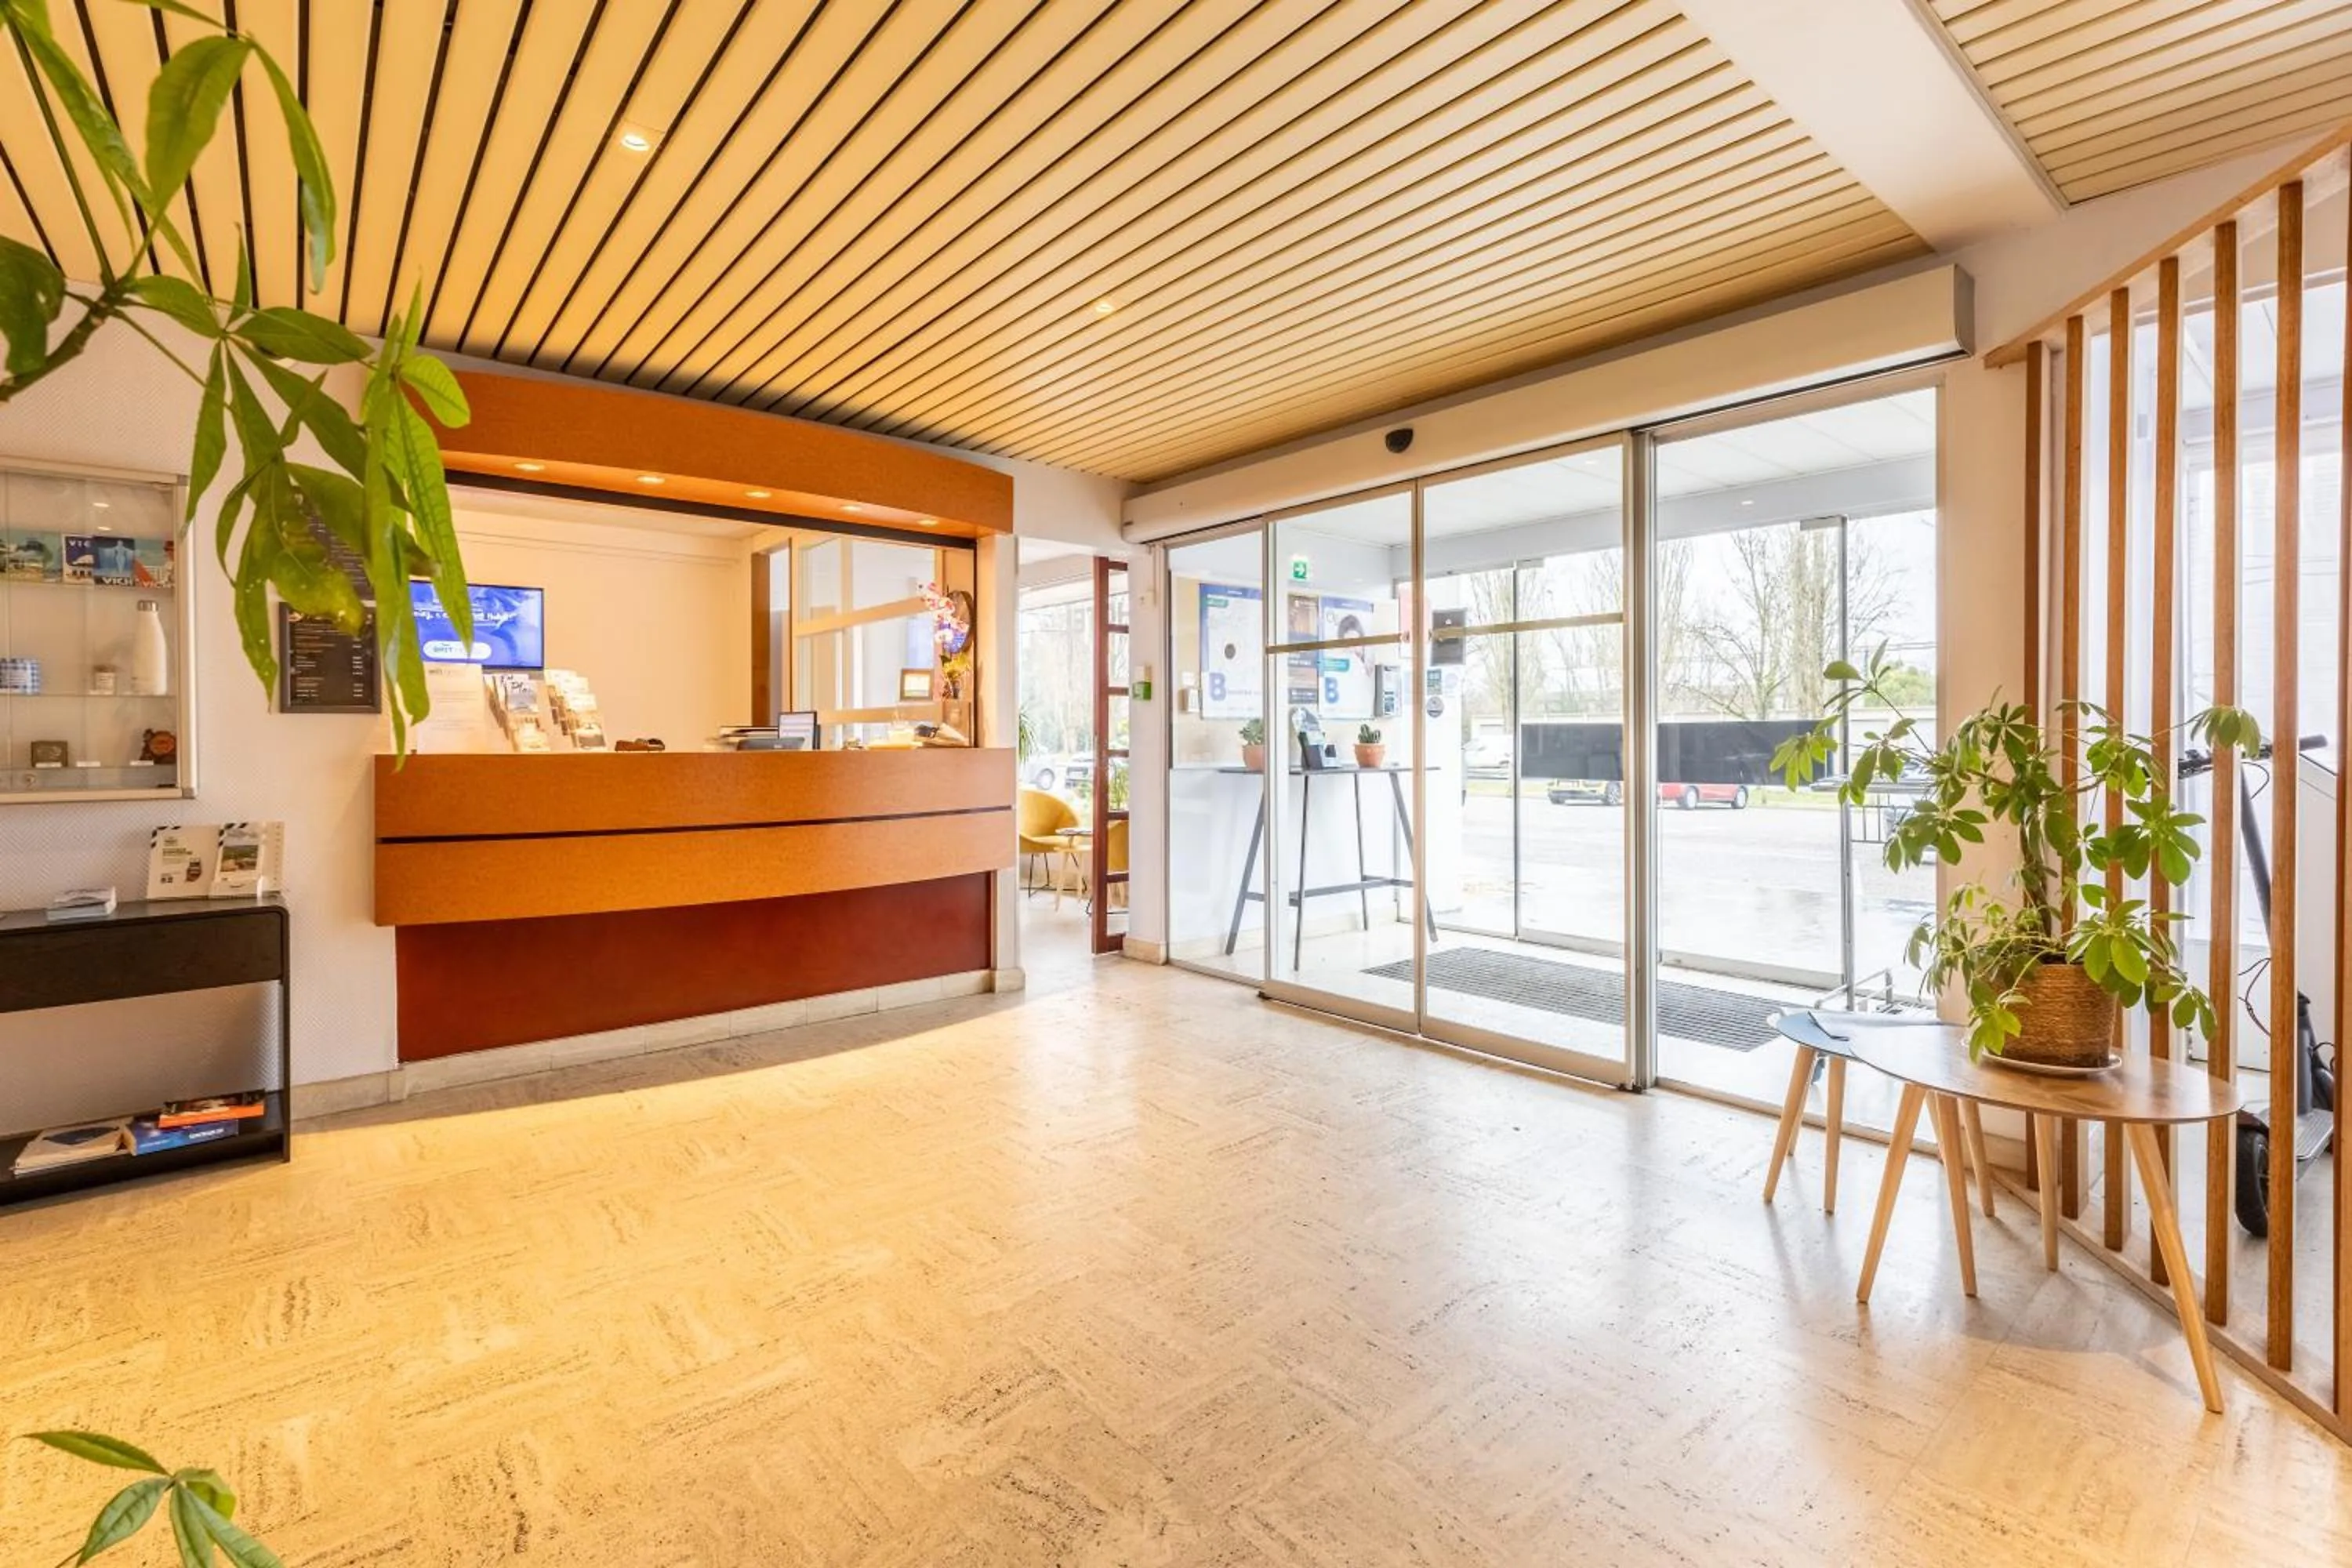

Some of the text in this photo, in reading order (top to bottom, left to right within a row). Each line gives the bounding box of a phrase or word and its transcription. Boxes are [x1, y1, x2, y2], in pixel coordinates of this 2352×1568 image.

[101, 576, 132, 586] VICH
[1209, 673, 1226, 701] B
[1325, 677, 1339, 704] B
